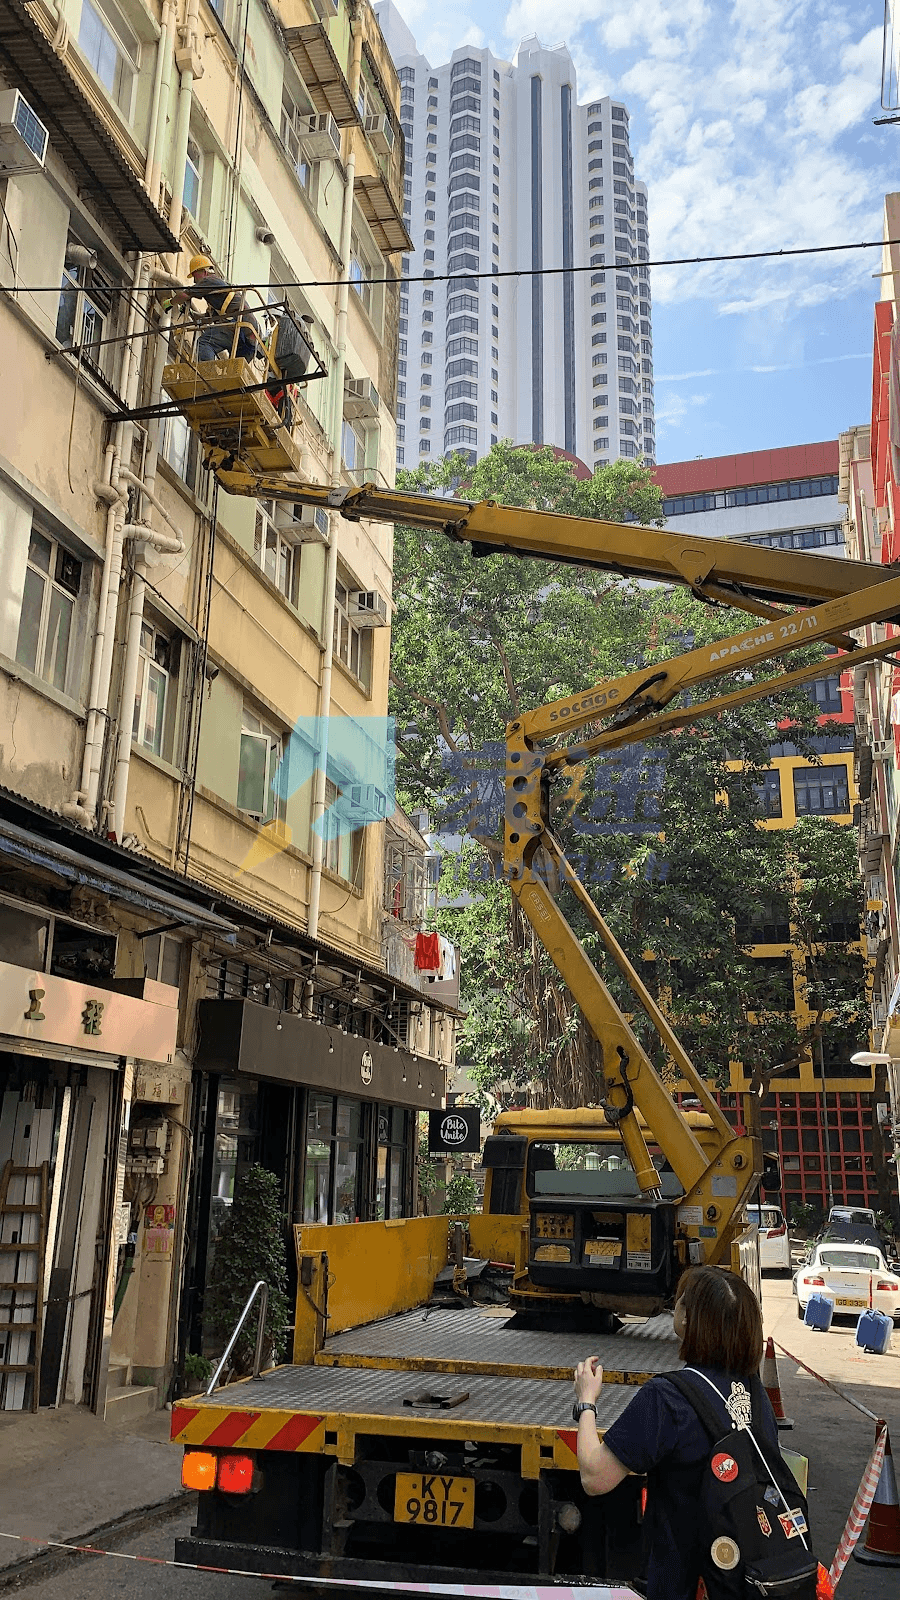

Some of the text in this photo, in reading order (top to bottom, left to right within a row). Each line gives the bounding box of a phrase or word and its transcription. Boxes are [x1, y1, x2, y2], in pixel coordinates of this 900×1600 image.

[709, 614, 818, 662] APACHE 22/11
[549, 688, 620, 722] socage
[440, 1128, 465, 1141] Unite
[446, 1118, 465, 1130] Bite
[421, 1475, 454, 1501] KY
[406, 1497, 465, 1525] 9817
